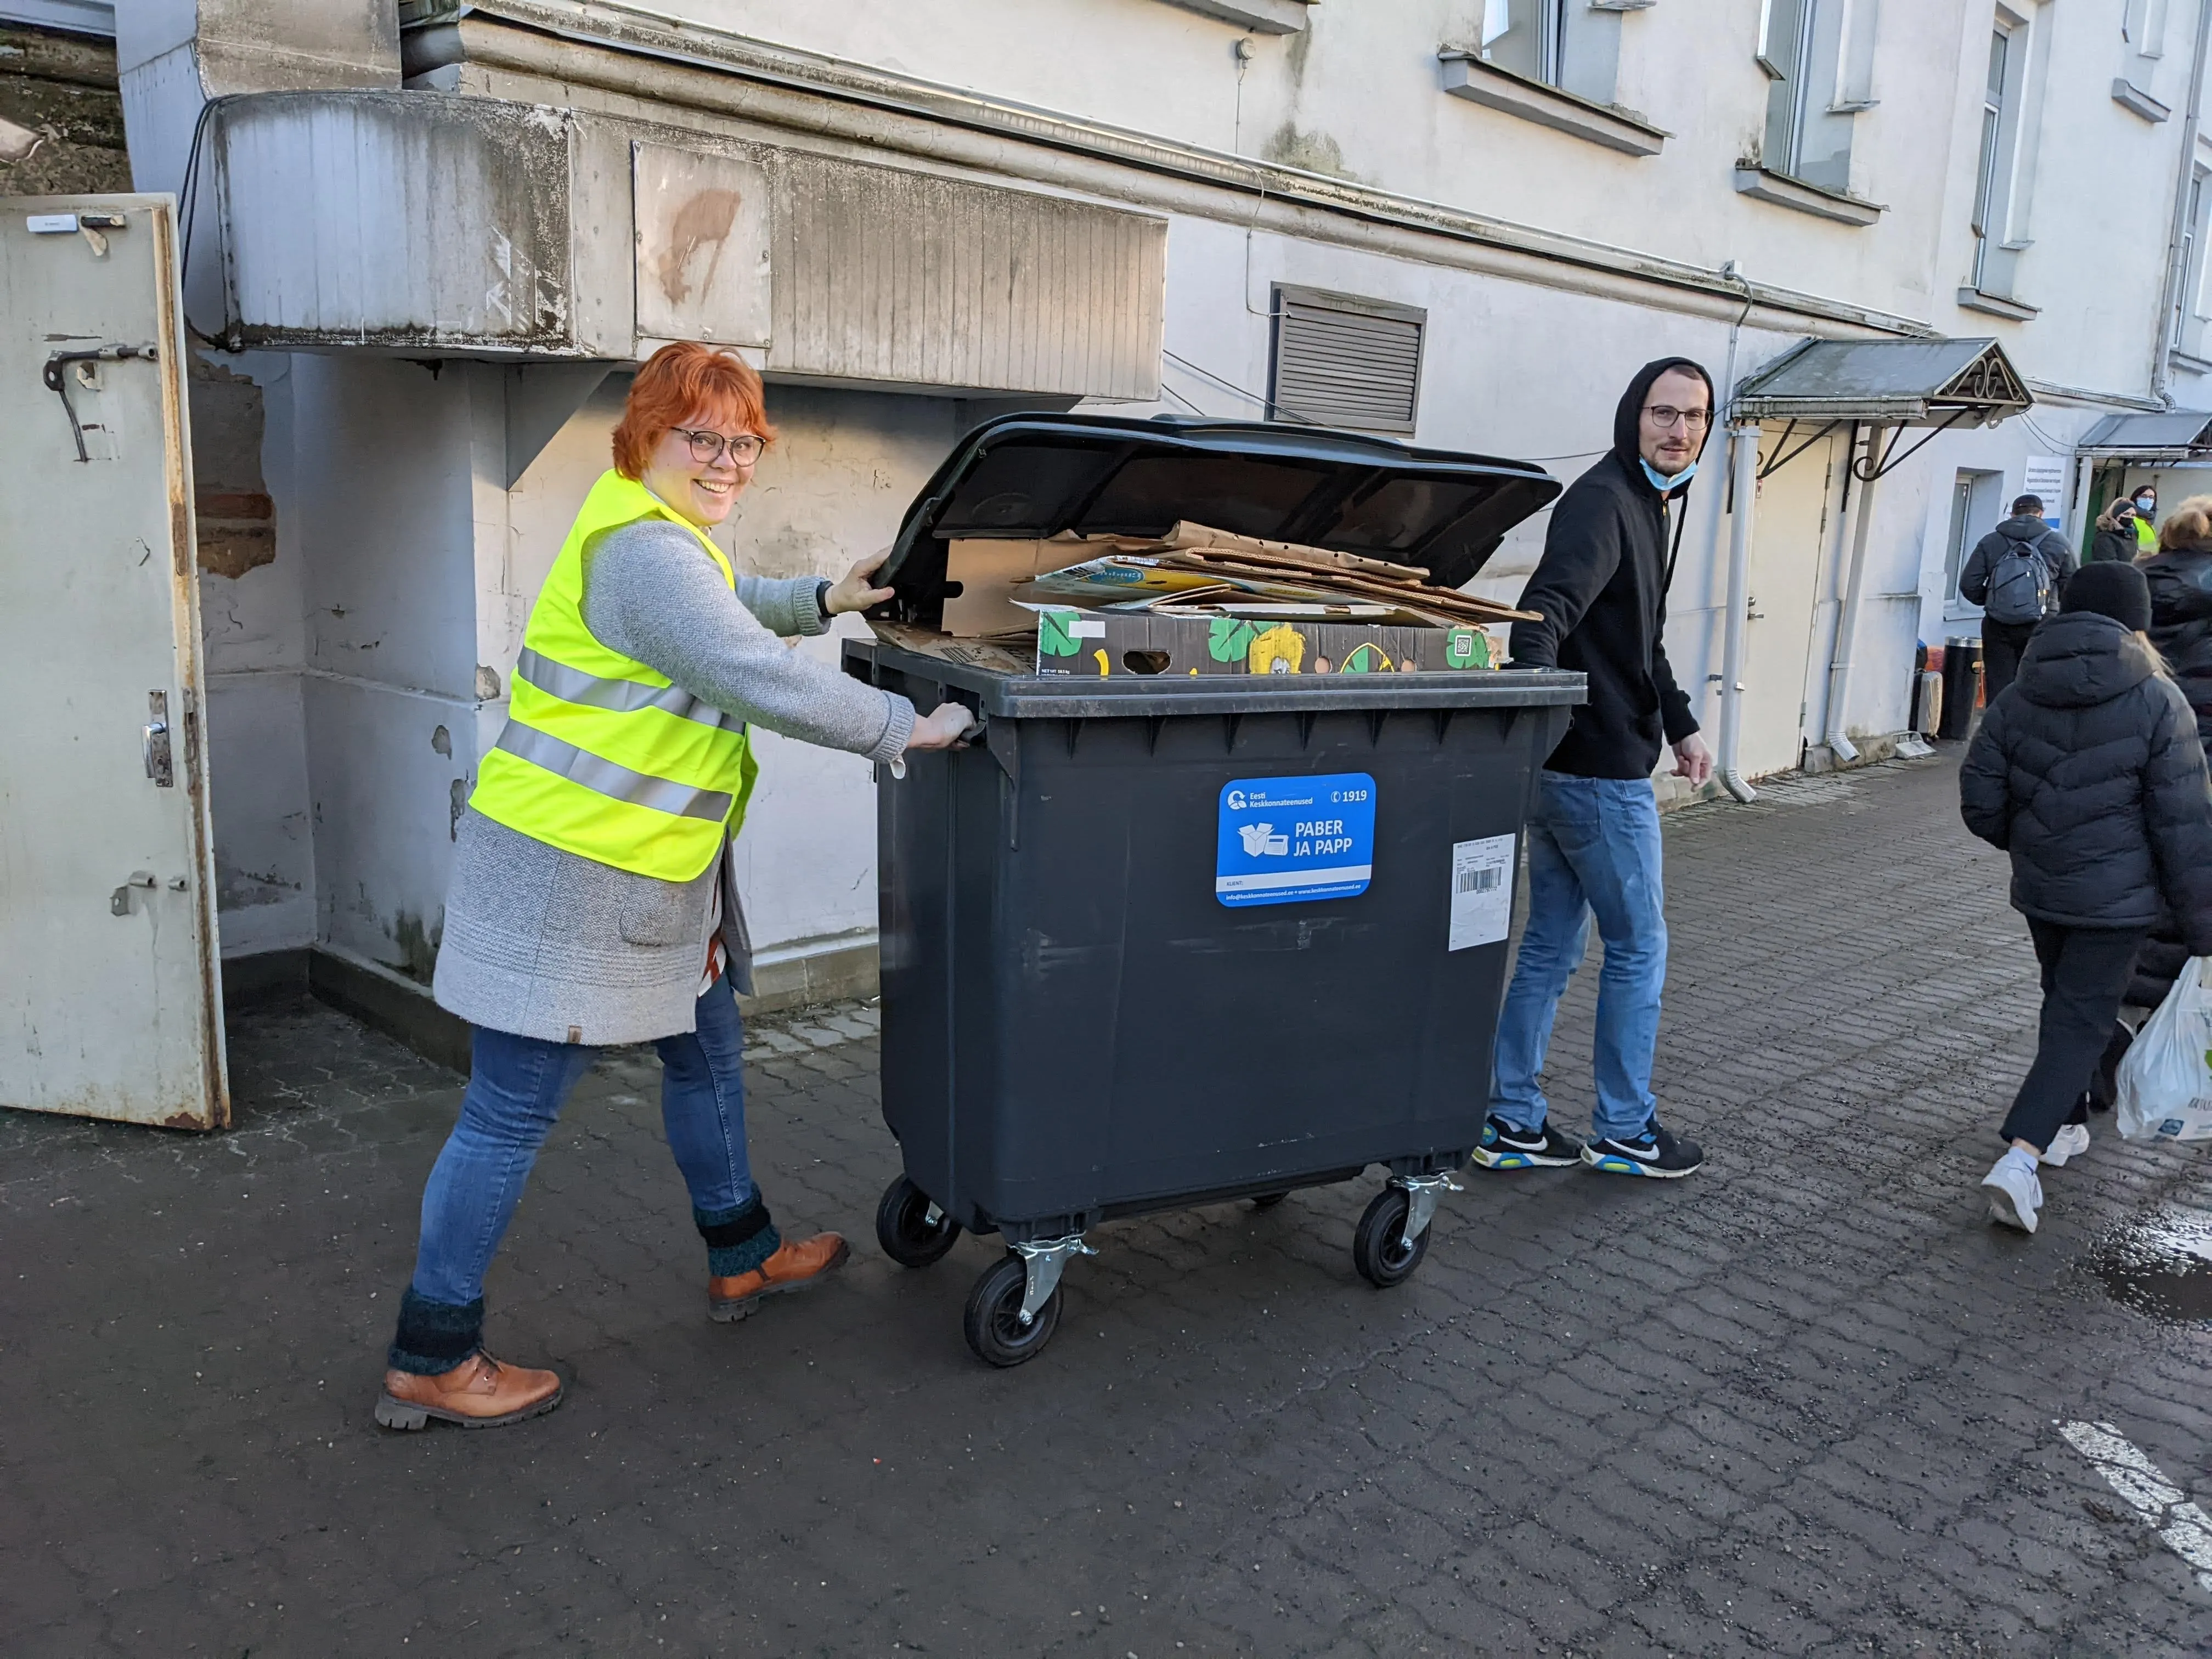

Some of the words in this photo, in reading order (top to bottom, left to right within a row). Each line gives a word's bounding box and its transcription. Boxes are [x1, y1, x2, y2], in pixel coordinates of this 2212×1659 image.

[1250, 797, 1313, 808] Keskkonnateenused
[1342, 790, 1367, 803] 1919
[1295, 819, 1343, 838] PABER
[1293, 841, 1311, 857] JA
[1314, 838, 1353, 855] PAPP
[1226, 890, 1294, 900] info@keskkonnateenused.ee
[1298, 884, 1361, 895] www.keskkonnateenused.ee
